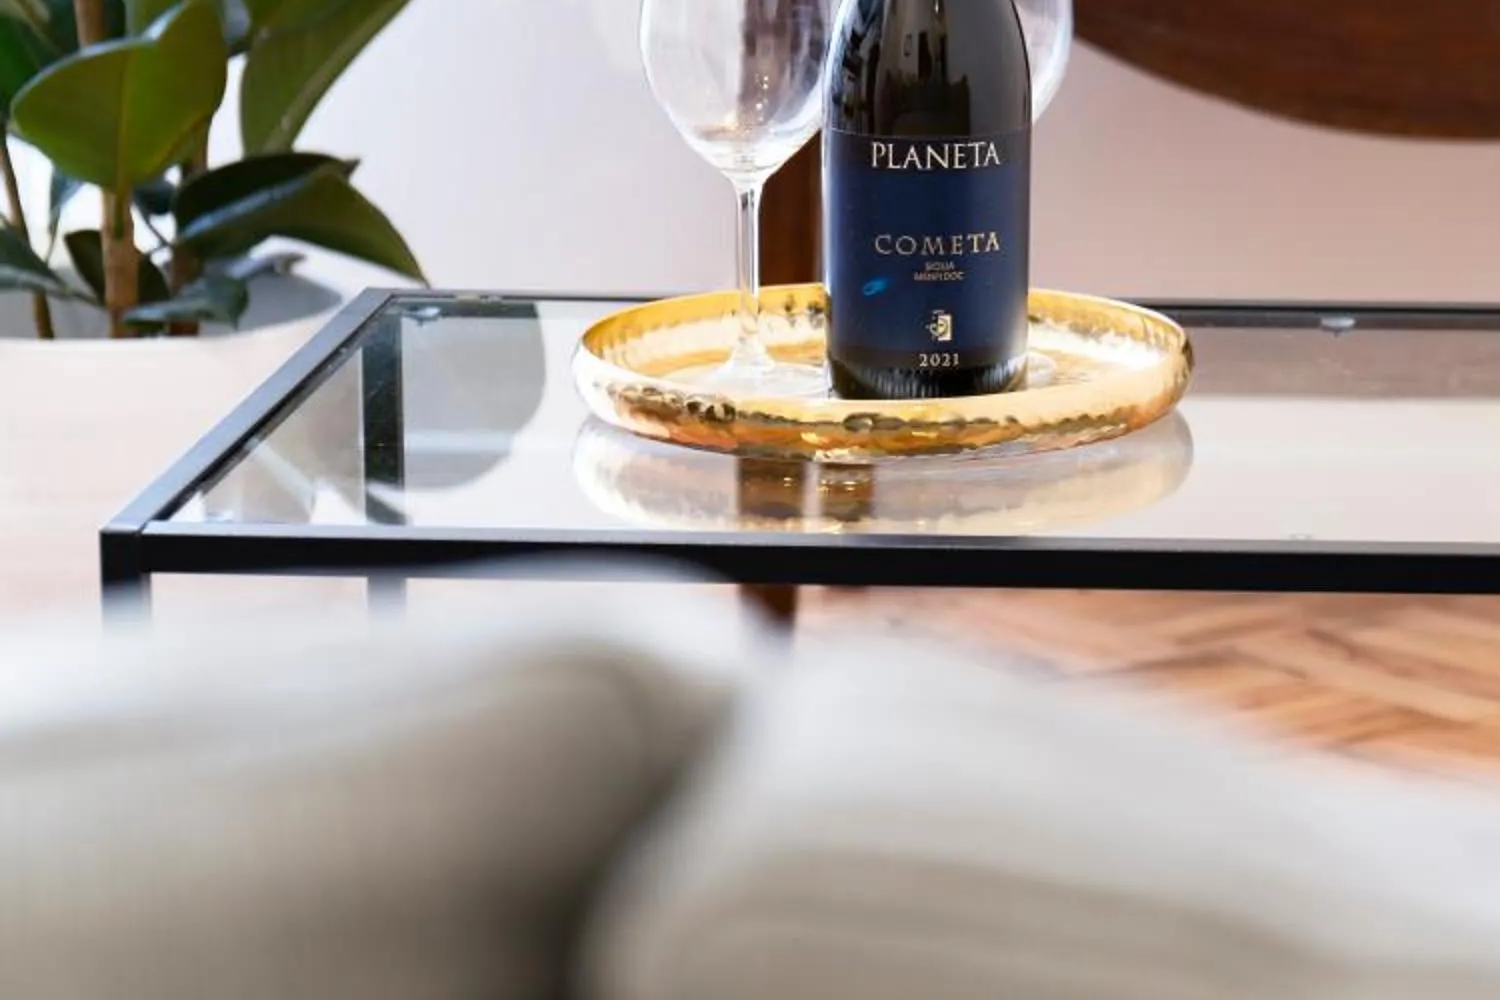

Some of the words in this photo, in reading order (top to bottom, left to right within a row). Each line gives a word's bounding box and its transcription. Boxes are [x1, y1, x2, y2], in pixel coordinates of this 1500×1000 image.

[871, 141, 1001, 170] PLANETA
[874, 231, 1000, 256] COMETA
[919, 352, 960, 367] 2021
